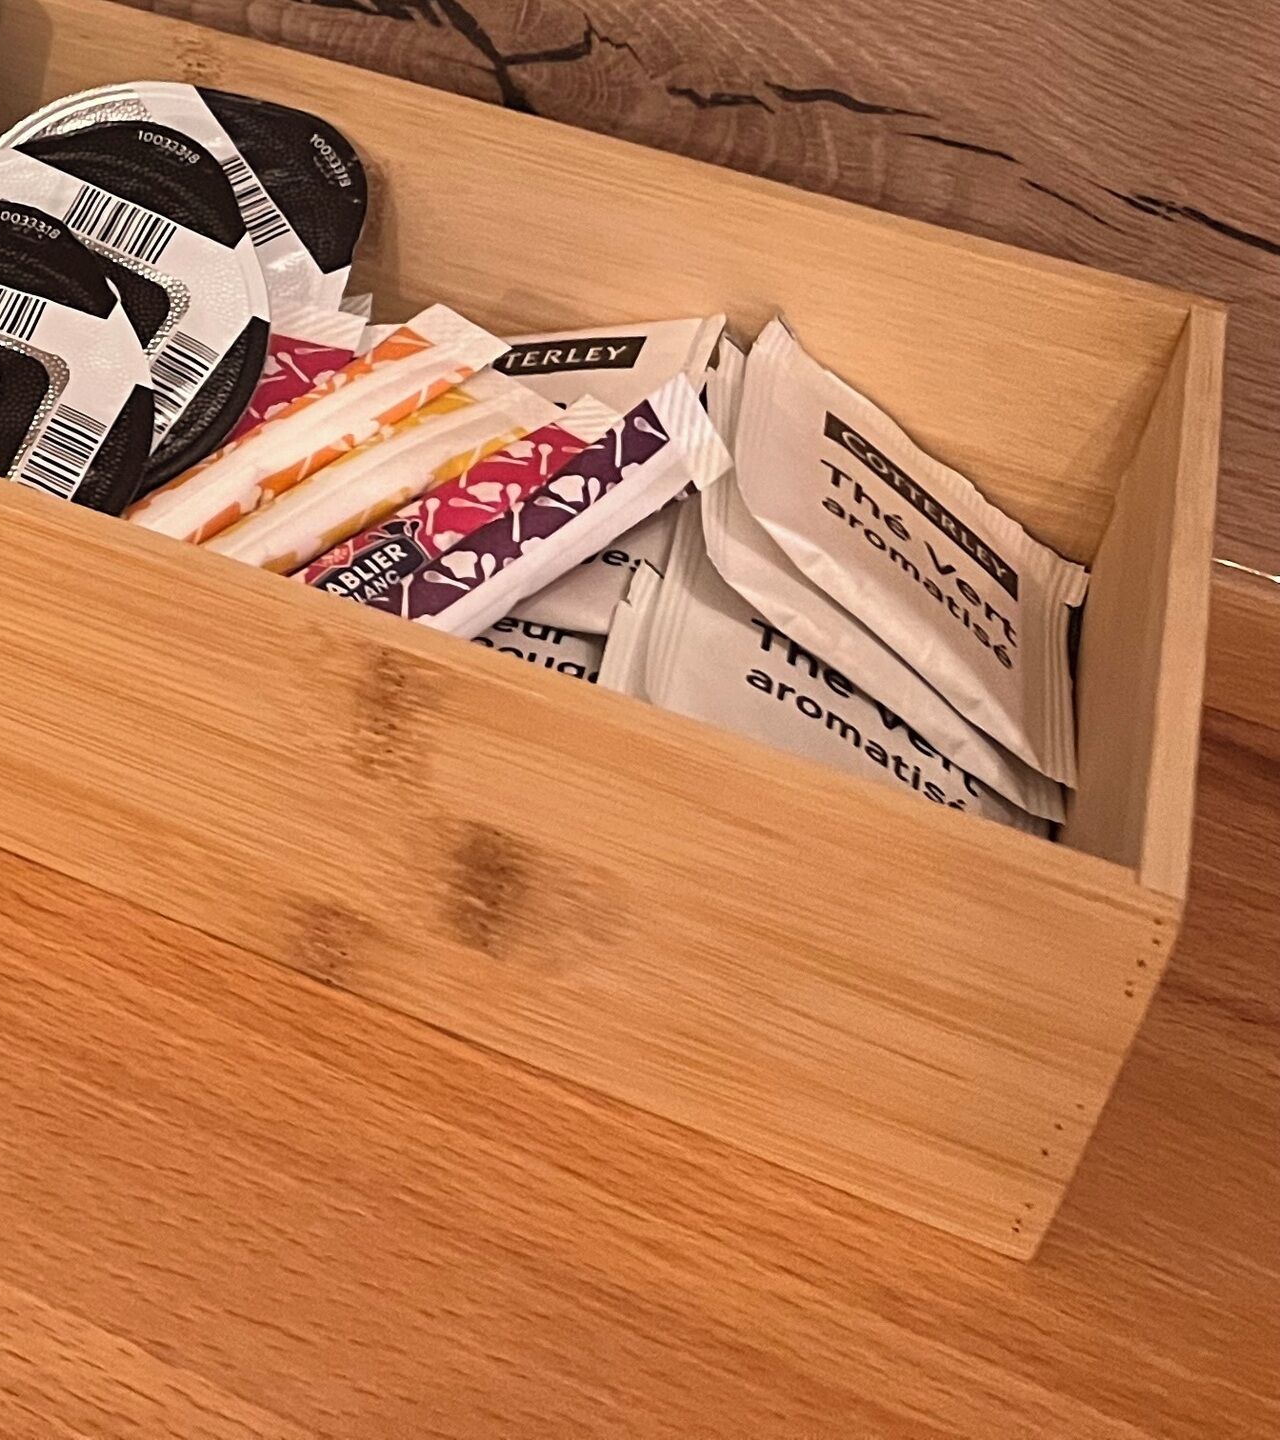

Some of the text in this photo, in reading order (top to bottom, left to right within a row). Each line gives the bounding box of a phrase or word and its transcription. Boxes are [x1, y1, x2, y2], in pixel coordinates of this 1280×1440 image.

[137, 130, 201, 164] 10033318
[820, 459, 1018, 649] Thé Vert
[821, 497, 1014, 670] aromatisé
[841, 430, 1007, 579] COTTERLEY
